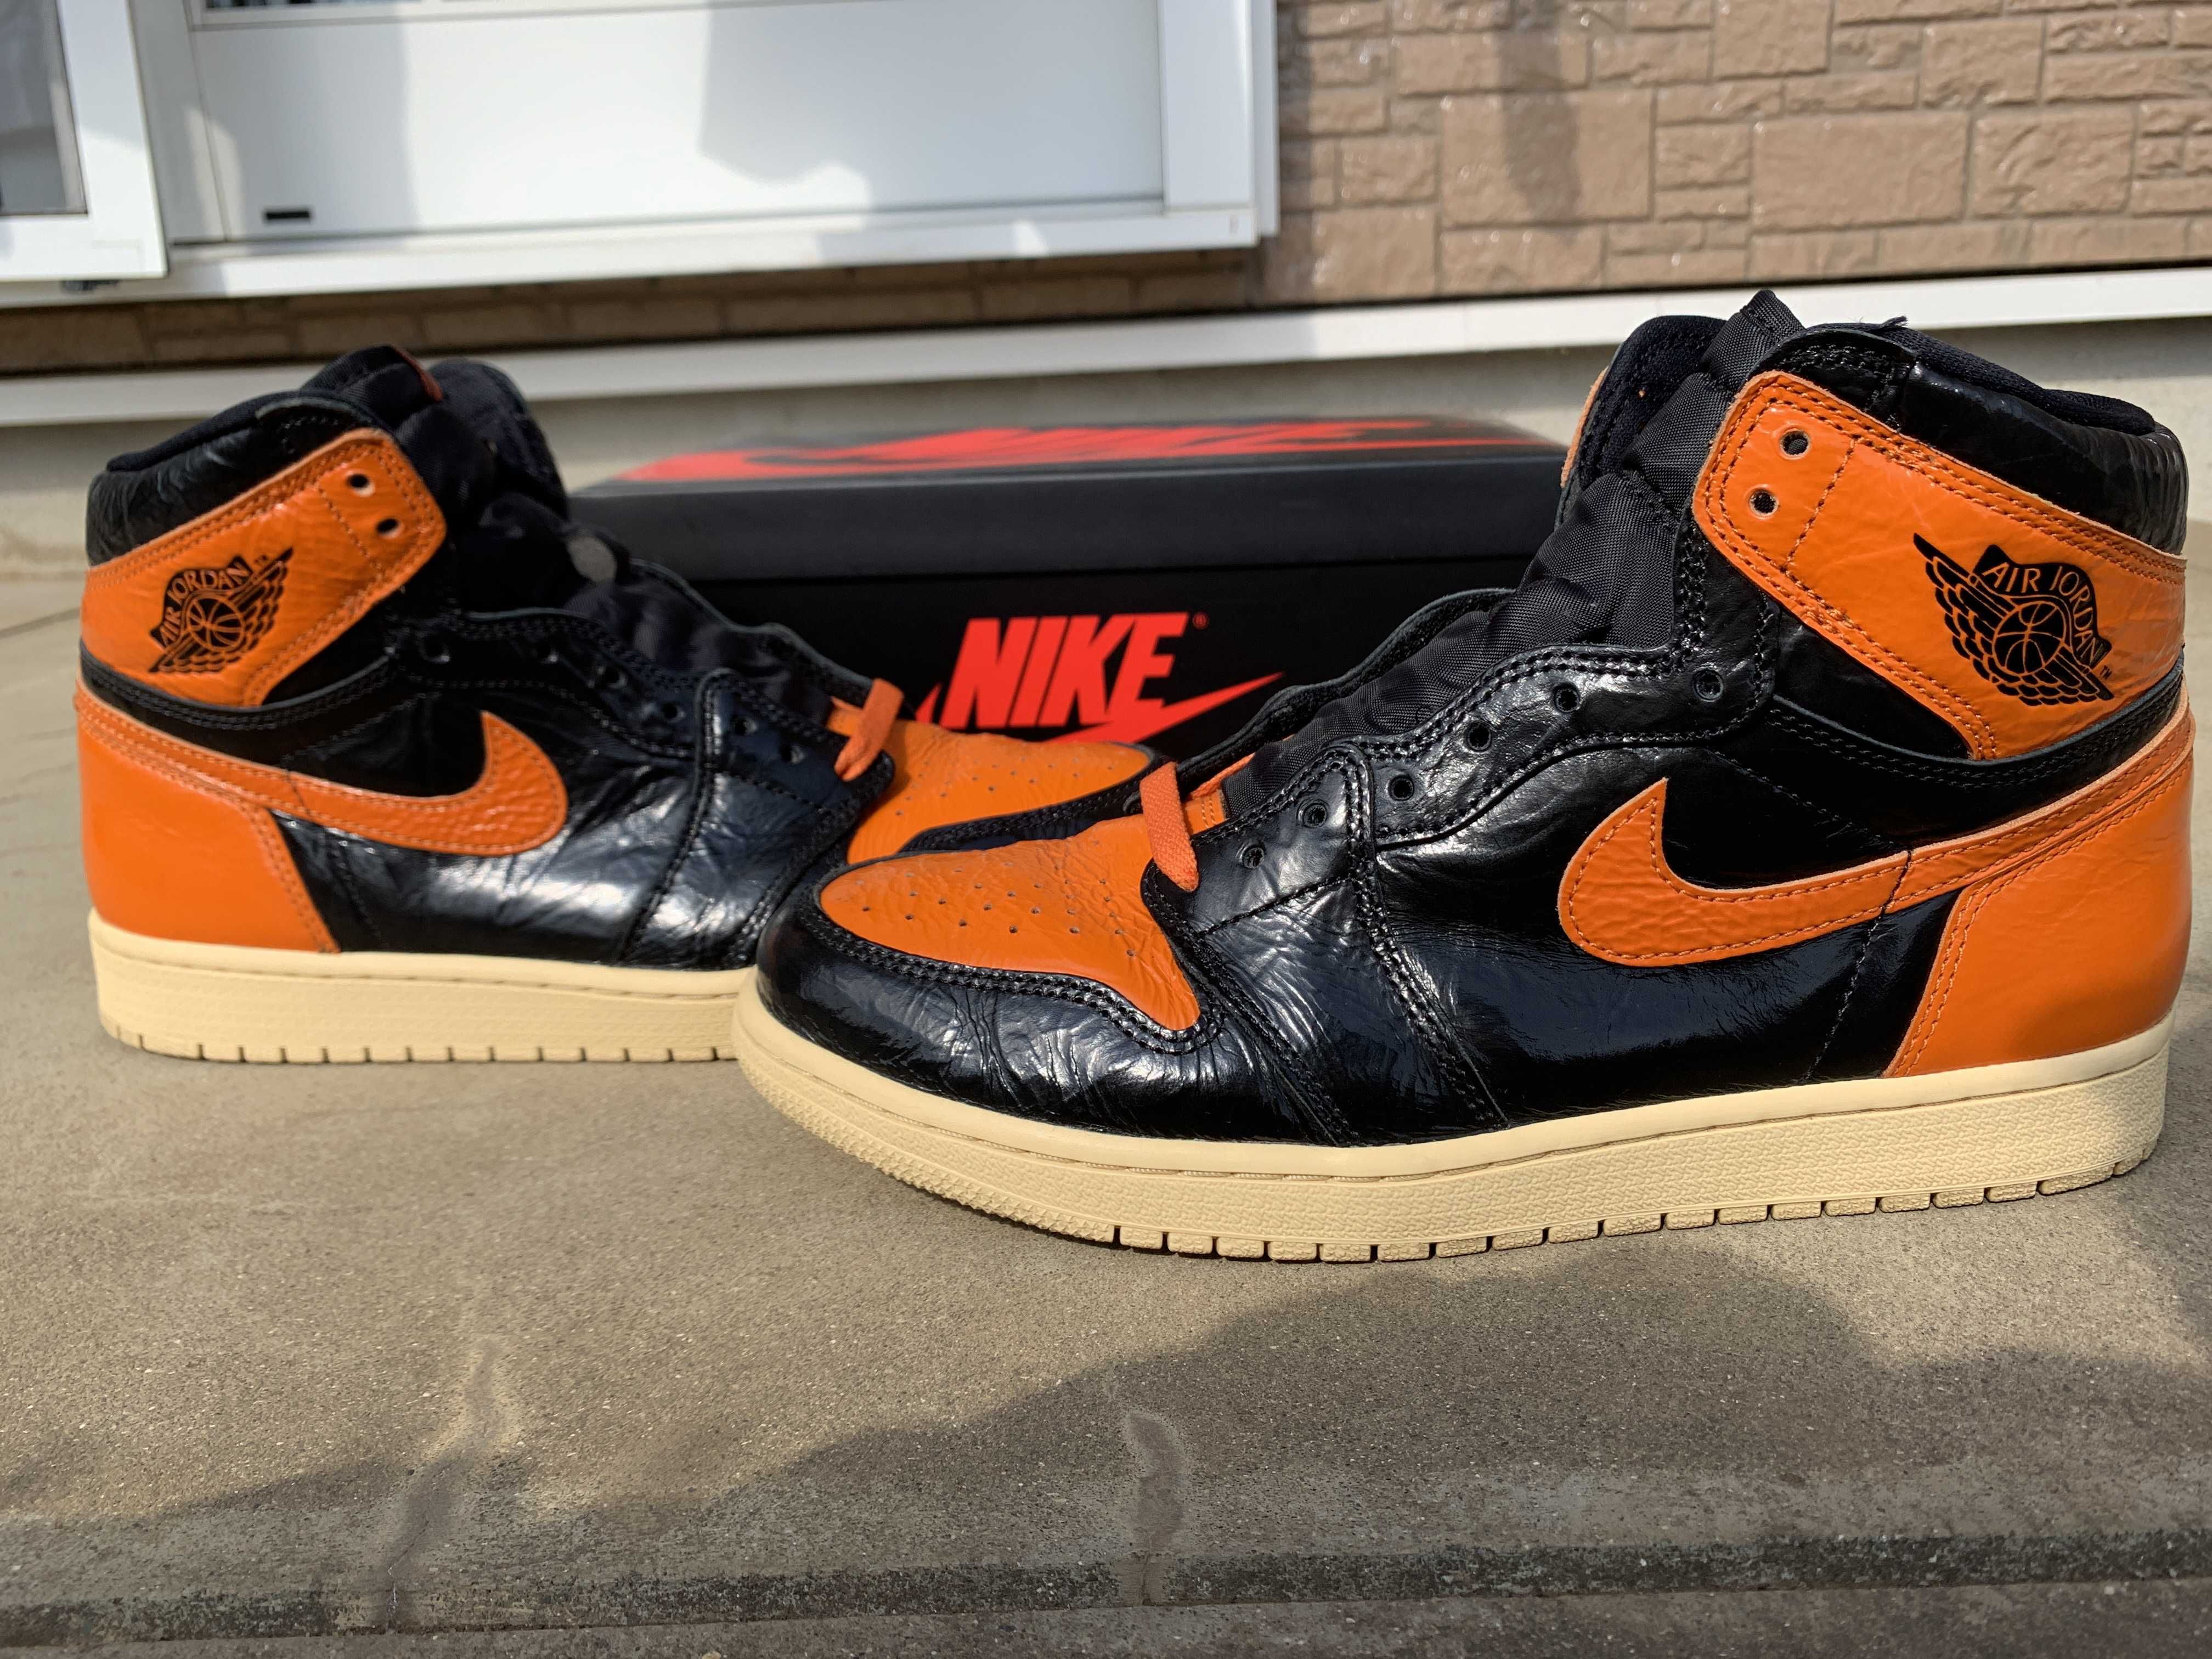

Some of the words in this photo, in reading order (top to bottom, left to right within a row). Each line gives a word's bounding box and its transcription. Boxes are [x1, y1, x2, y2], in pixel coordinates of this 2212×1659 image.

[166, 561, 251, 605] JORDAN
[1982, 562, 2041, 593] AIR
[2049, 566, 2103, 664] JORDAN
[159, 606, 182, 647] AIR
[940, 612, 1189, 729] NIKE
